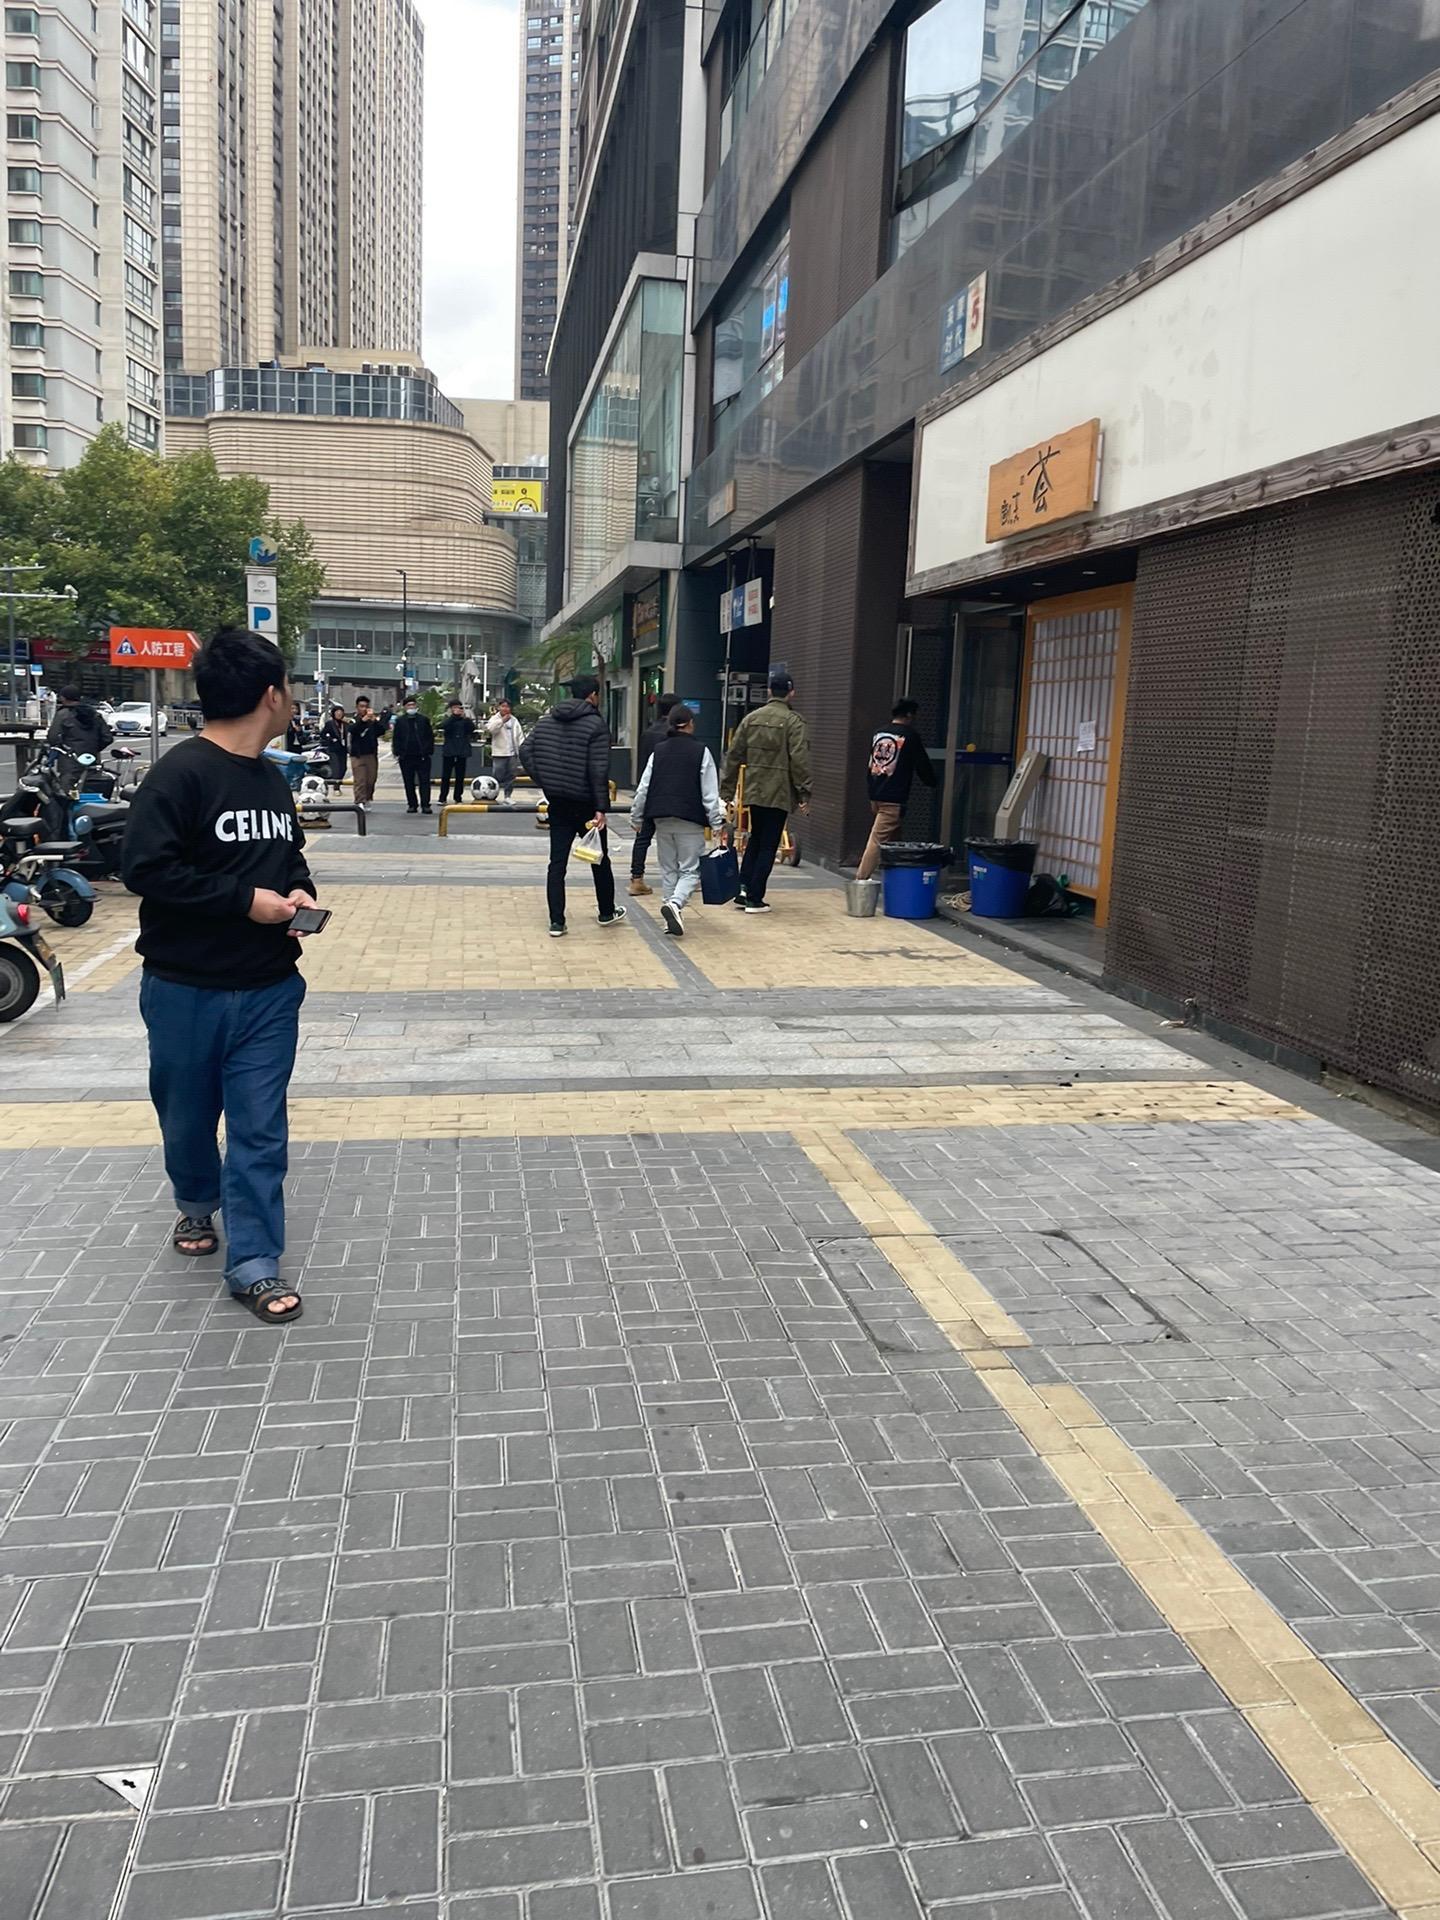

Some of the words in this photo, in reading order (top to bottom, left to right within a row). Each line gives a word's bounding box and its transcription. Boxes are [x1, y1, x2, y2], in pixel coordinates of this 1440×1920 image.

[254, 607, 271, 629] P
[140, 641, 186, 657] 人防工程
[215, 810, 293, 842] CELINE
